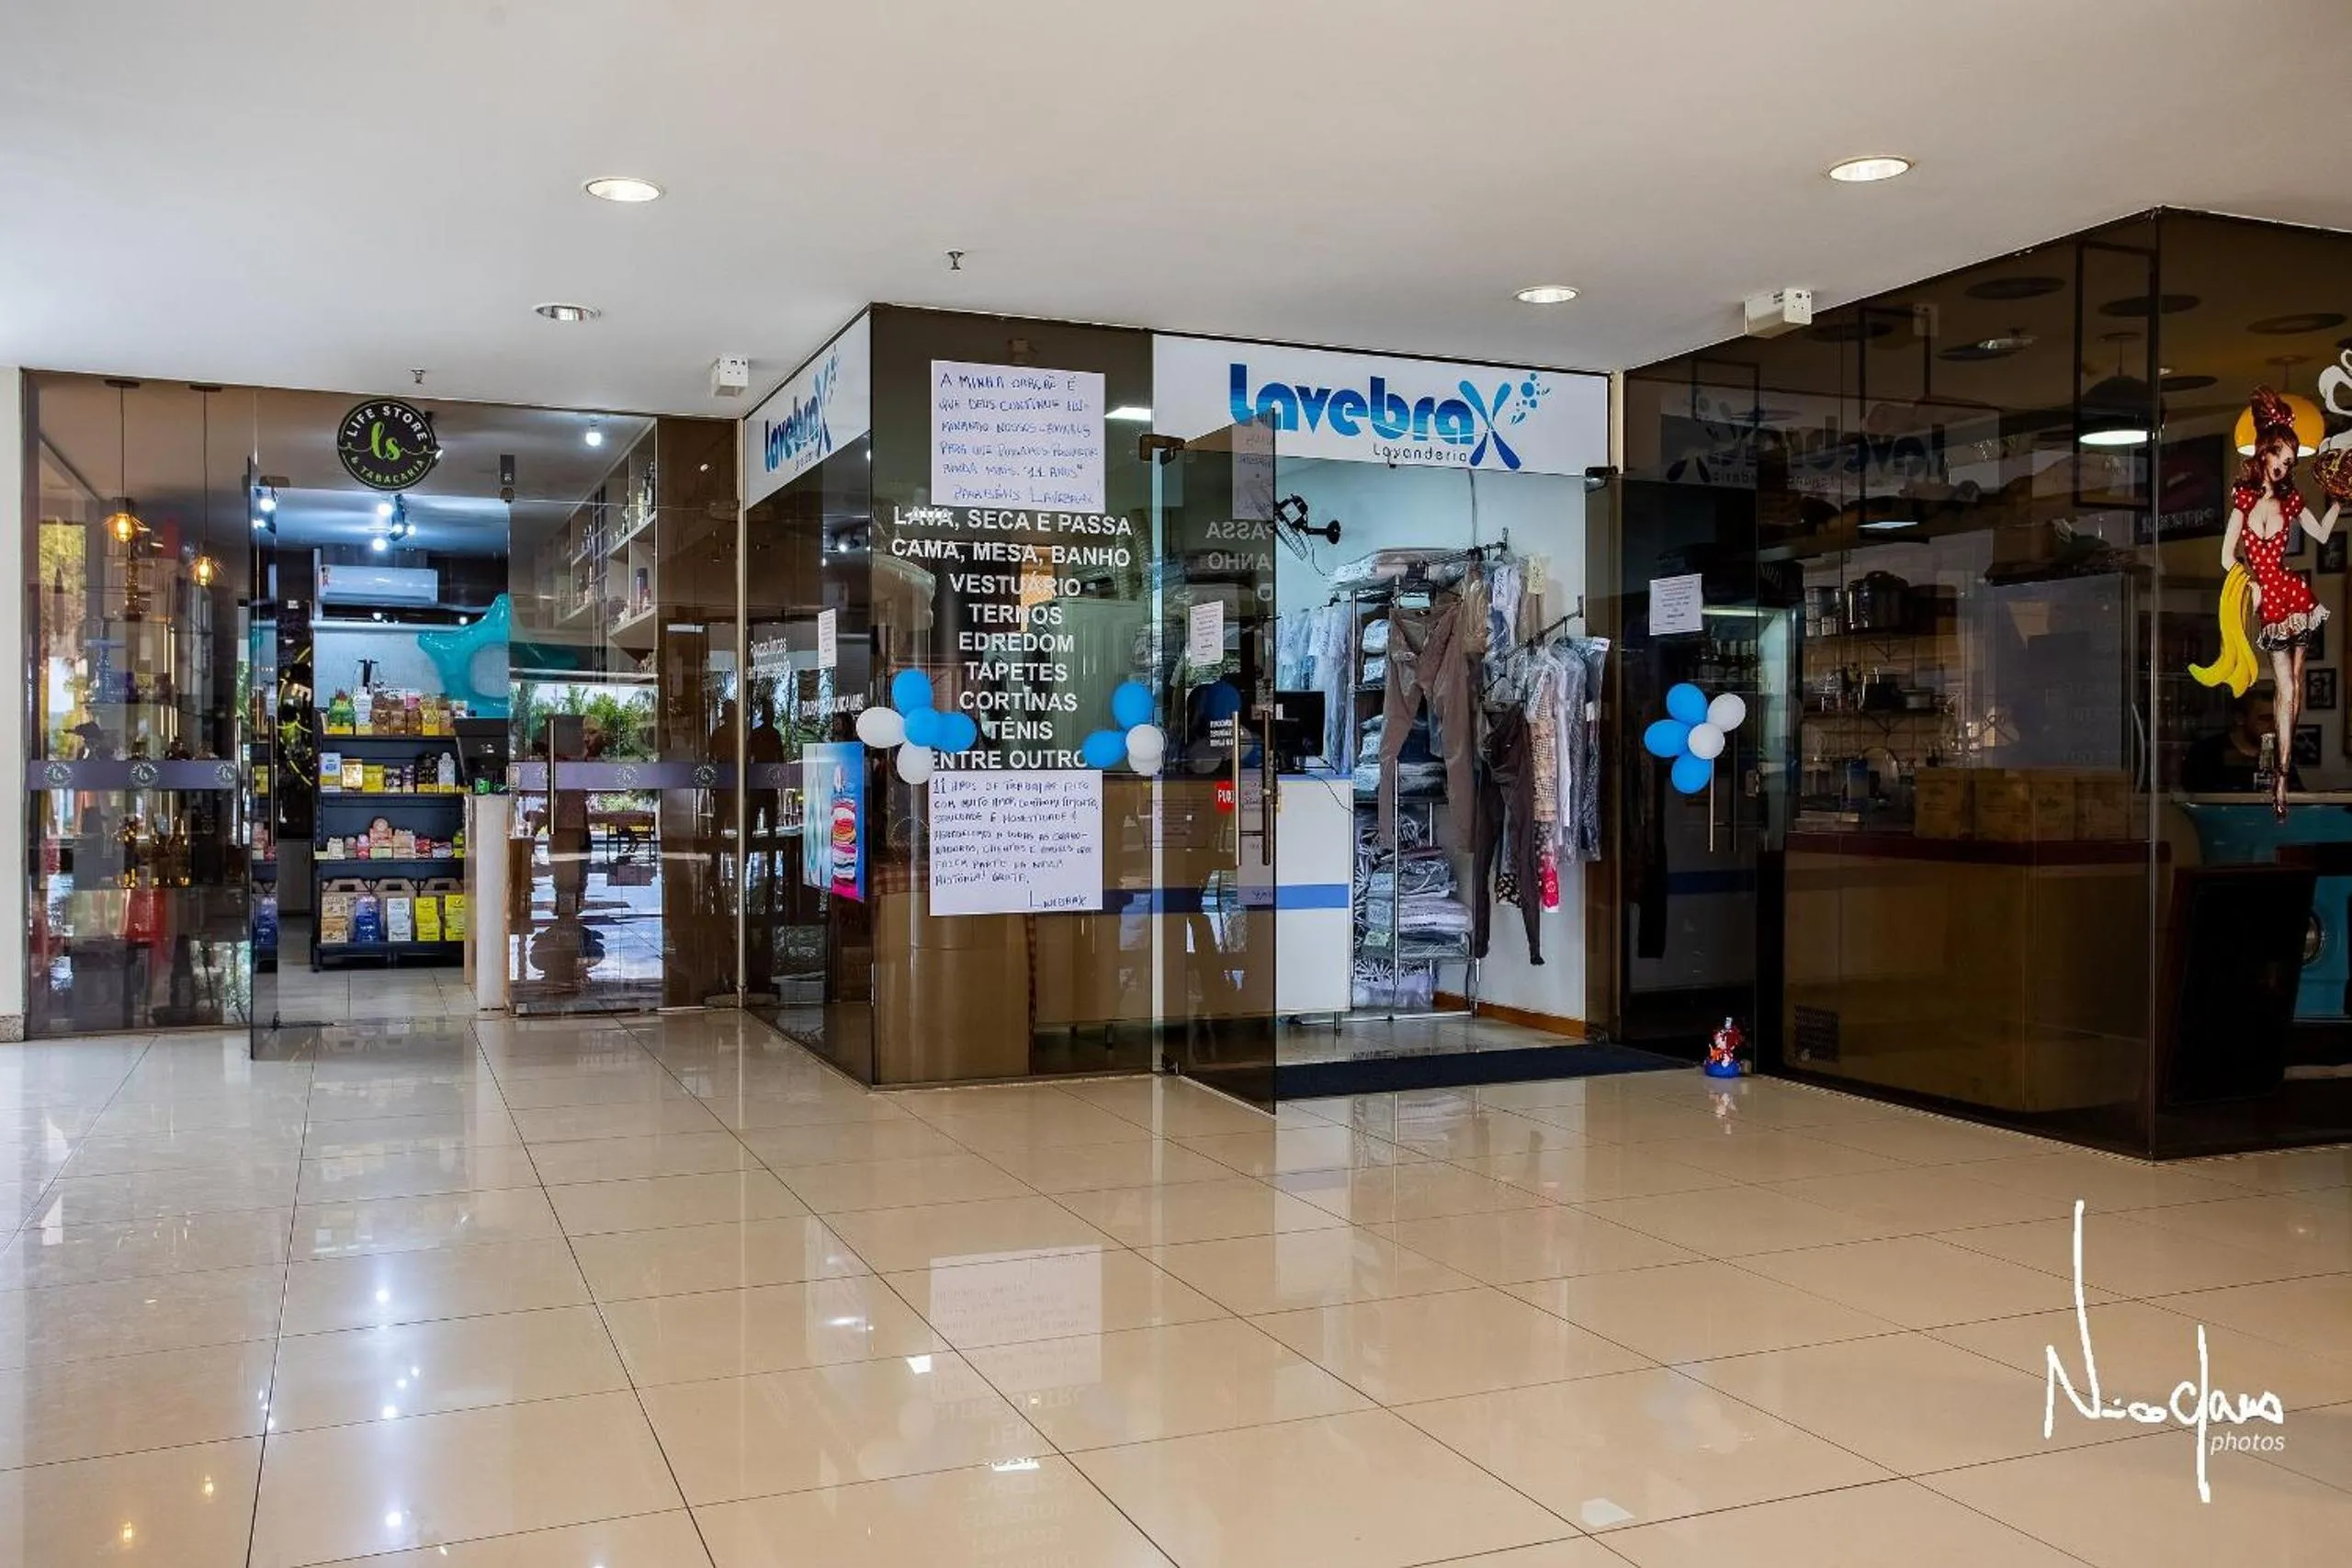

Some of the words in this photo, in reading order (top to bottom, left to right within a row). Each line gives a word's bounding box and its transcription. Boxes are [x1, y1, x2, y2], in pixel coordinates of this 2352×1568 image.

[940, 372, 953, 389] A
[958, 375, 1005, 389] MINHA
[345, 408, 376, 437] LIFE
[382, 405, 427, 441] STORE
[1373, 443, 1467, 463] Lavanderia
[359, 459, 424, 484] TABACARIA
[967, 509, 1031, 531] SECA
[1037, 513, 1051, 532] E
[1057, 514, 1133, 536] PASSA
[891, 538, 965, 563] CAMA,
[973, 542, 1044, 566] MESA,
[1051, 546, 1131, 567] BANHO
[948, 572, 1082, 597] VESTUÁRIO
[967, 603, 1064, 626] TERNOS
[965, 661, 1068, 682] TAPETES
[958, 691, 1078, 712] CORTINAS
[989, 716, 1054, 740] TÊNIS
[1009, 750, 1088, 770] OUTRO
